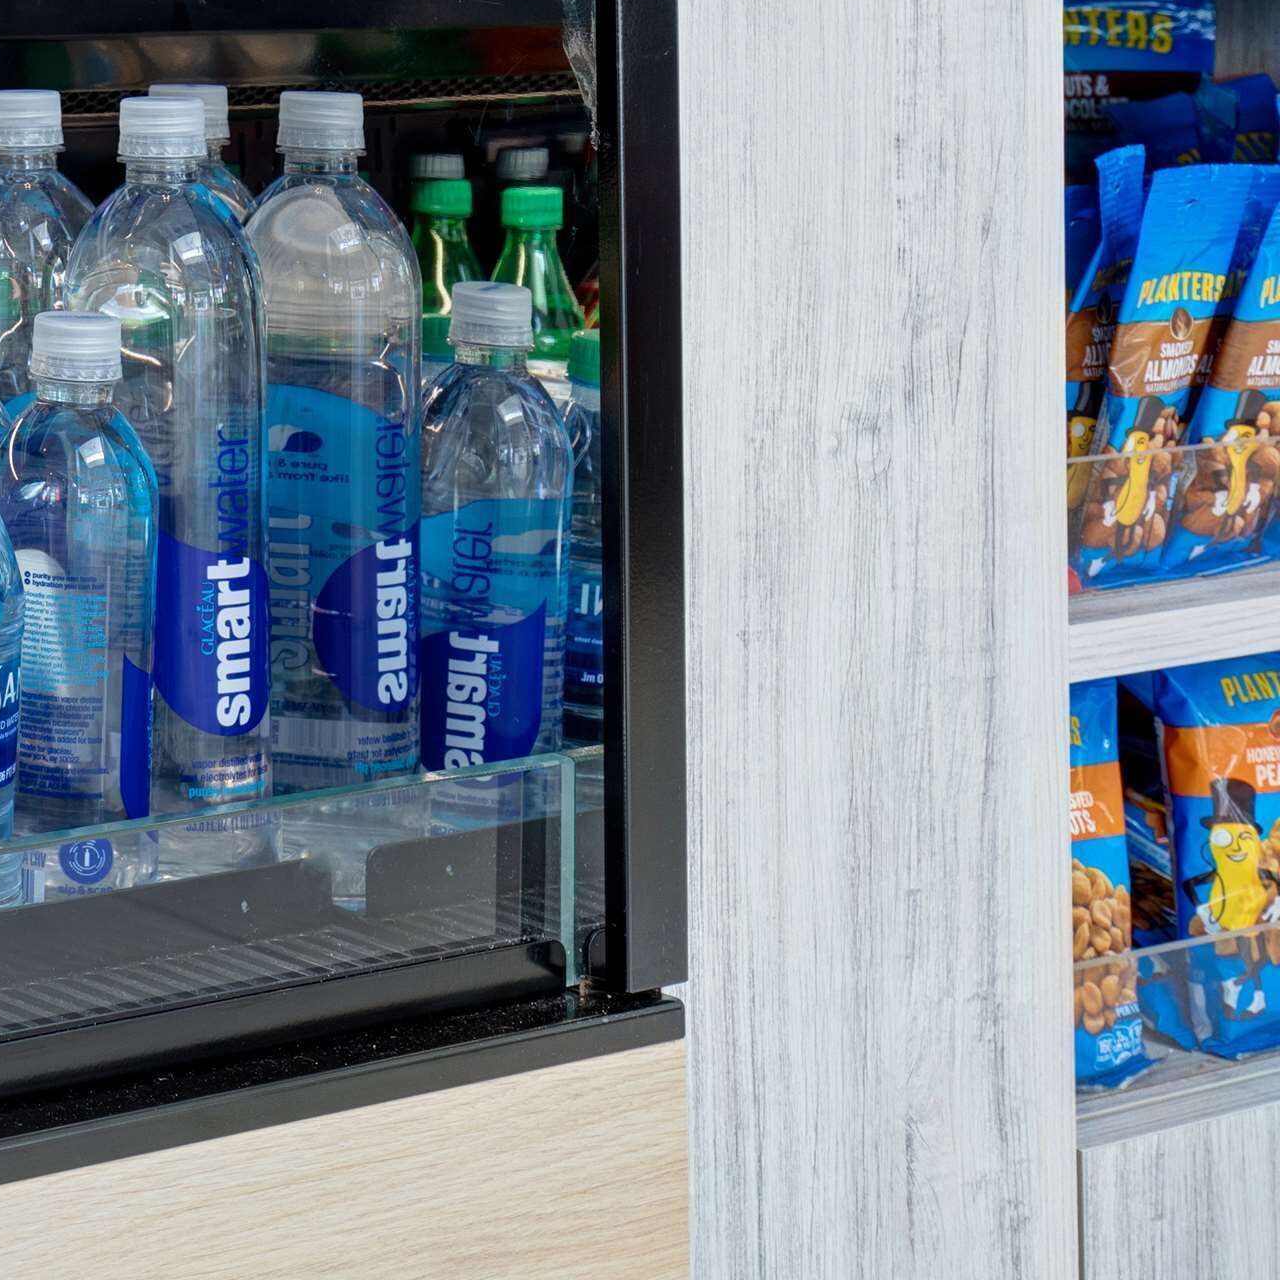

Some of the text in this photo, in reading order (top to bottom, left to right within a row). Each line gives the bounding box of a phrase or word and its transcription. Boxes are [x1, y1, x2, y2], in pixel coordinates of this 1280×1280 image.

[1137, 272, 1224, 308] PLANTERS
[1145, 355, 1198, 381] ALMONDS
[32, 572, 51, 581] purity
[32, 580, 63, 588] hydration
[207, 428, 252, 728] smart water
[200, 580, 215, 656] GLACÉAU
[191, 757, 216, 770] vapor
